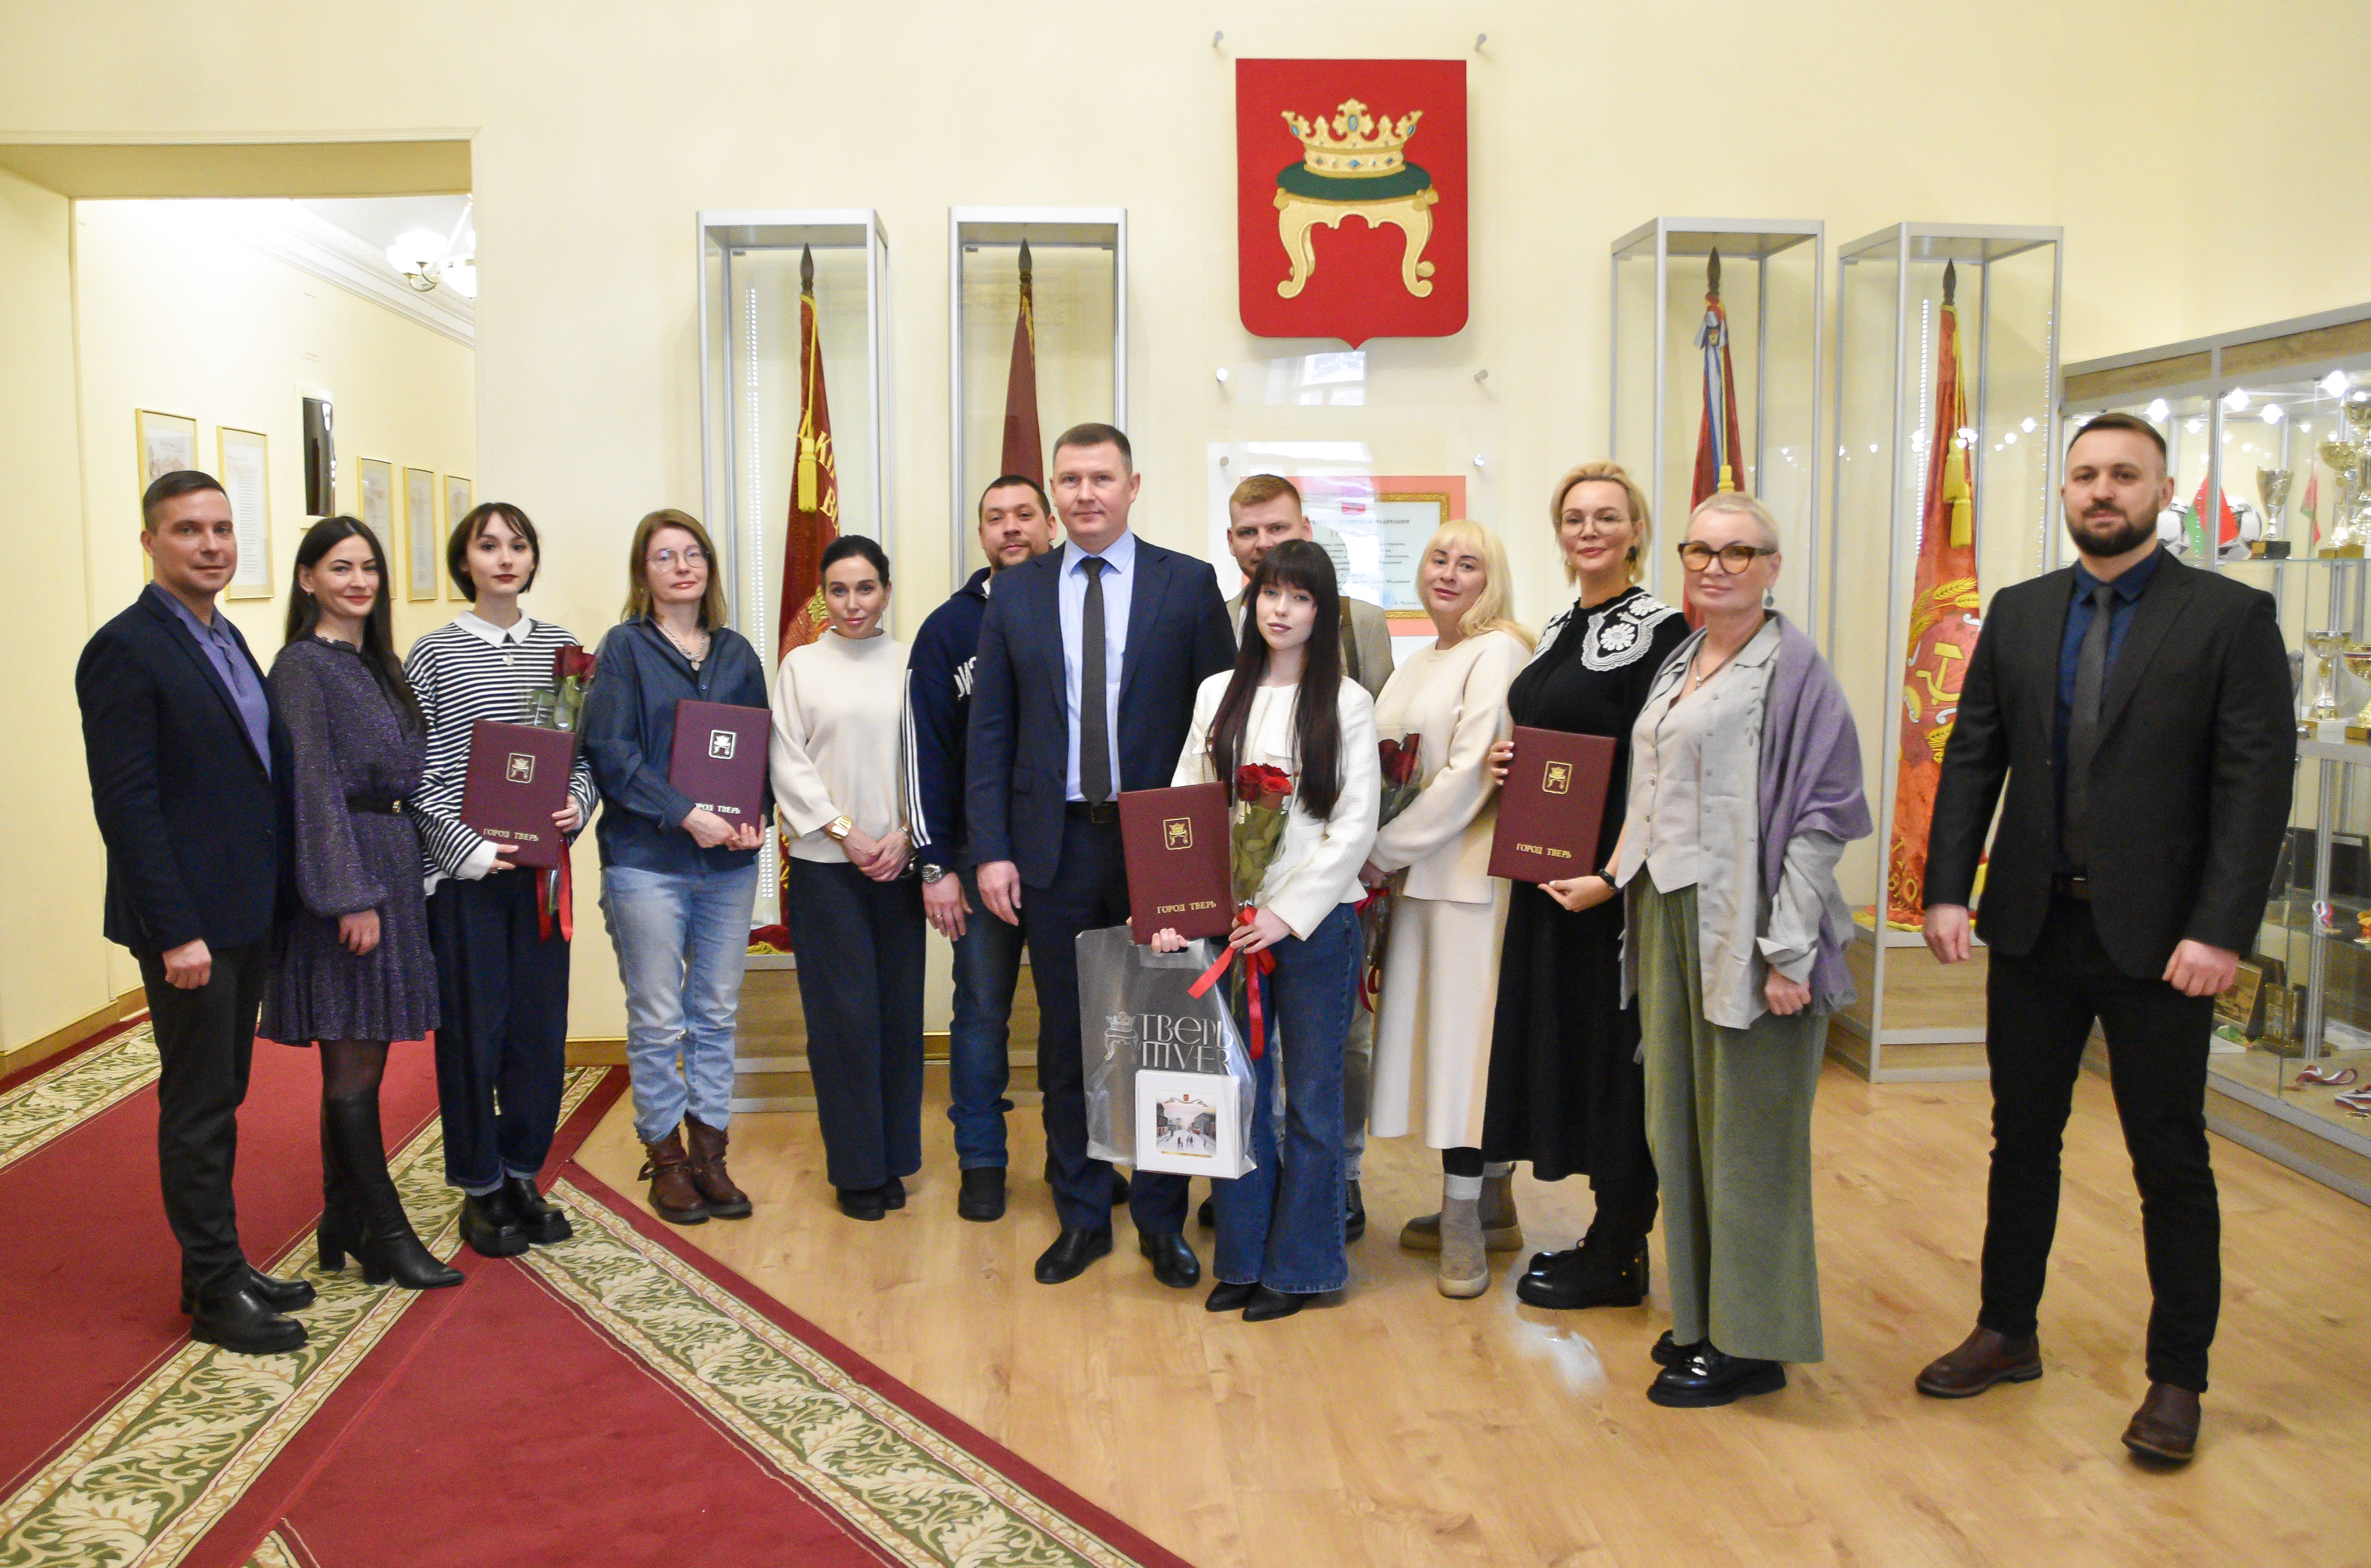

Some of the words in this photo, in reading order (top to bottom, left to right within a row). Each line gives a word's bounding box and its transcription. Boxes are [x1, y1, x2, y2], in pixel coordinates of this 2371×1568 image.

[717, 805, 741, 814] ТВЕРЬ
[483, 828, 510, 838] ГОРОД
[514, 832, 539, 841] ТВЕРЬ
[1516, 843, 1543, 855] ГОРОД
[1547, 848, 1572, 859] ТВЕРЬ
[1157, 904, 1186, 914] ГОРОД
[1189, 901, 1217, 910] ТВЕРЬ
